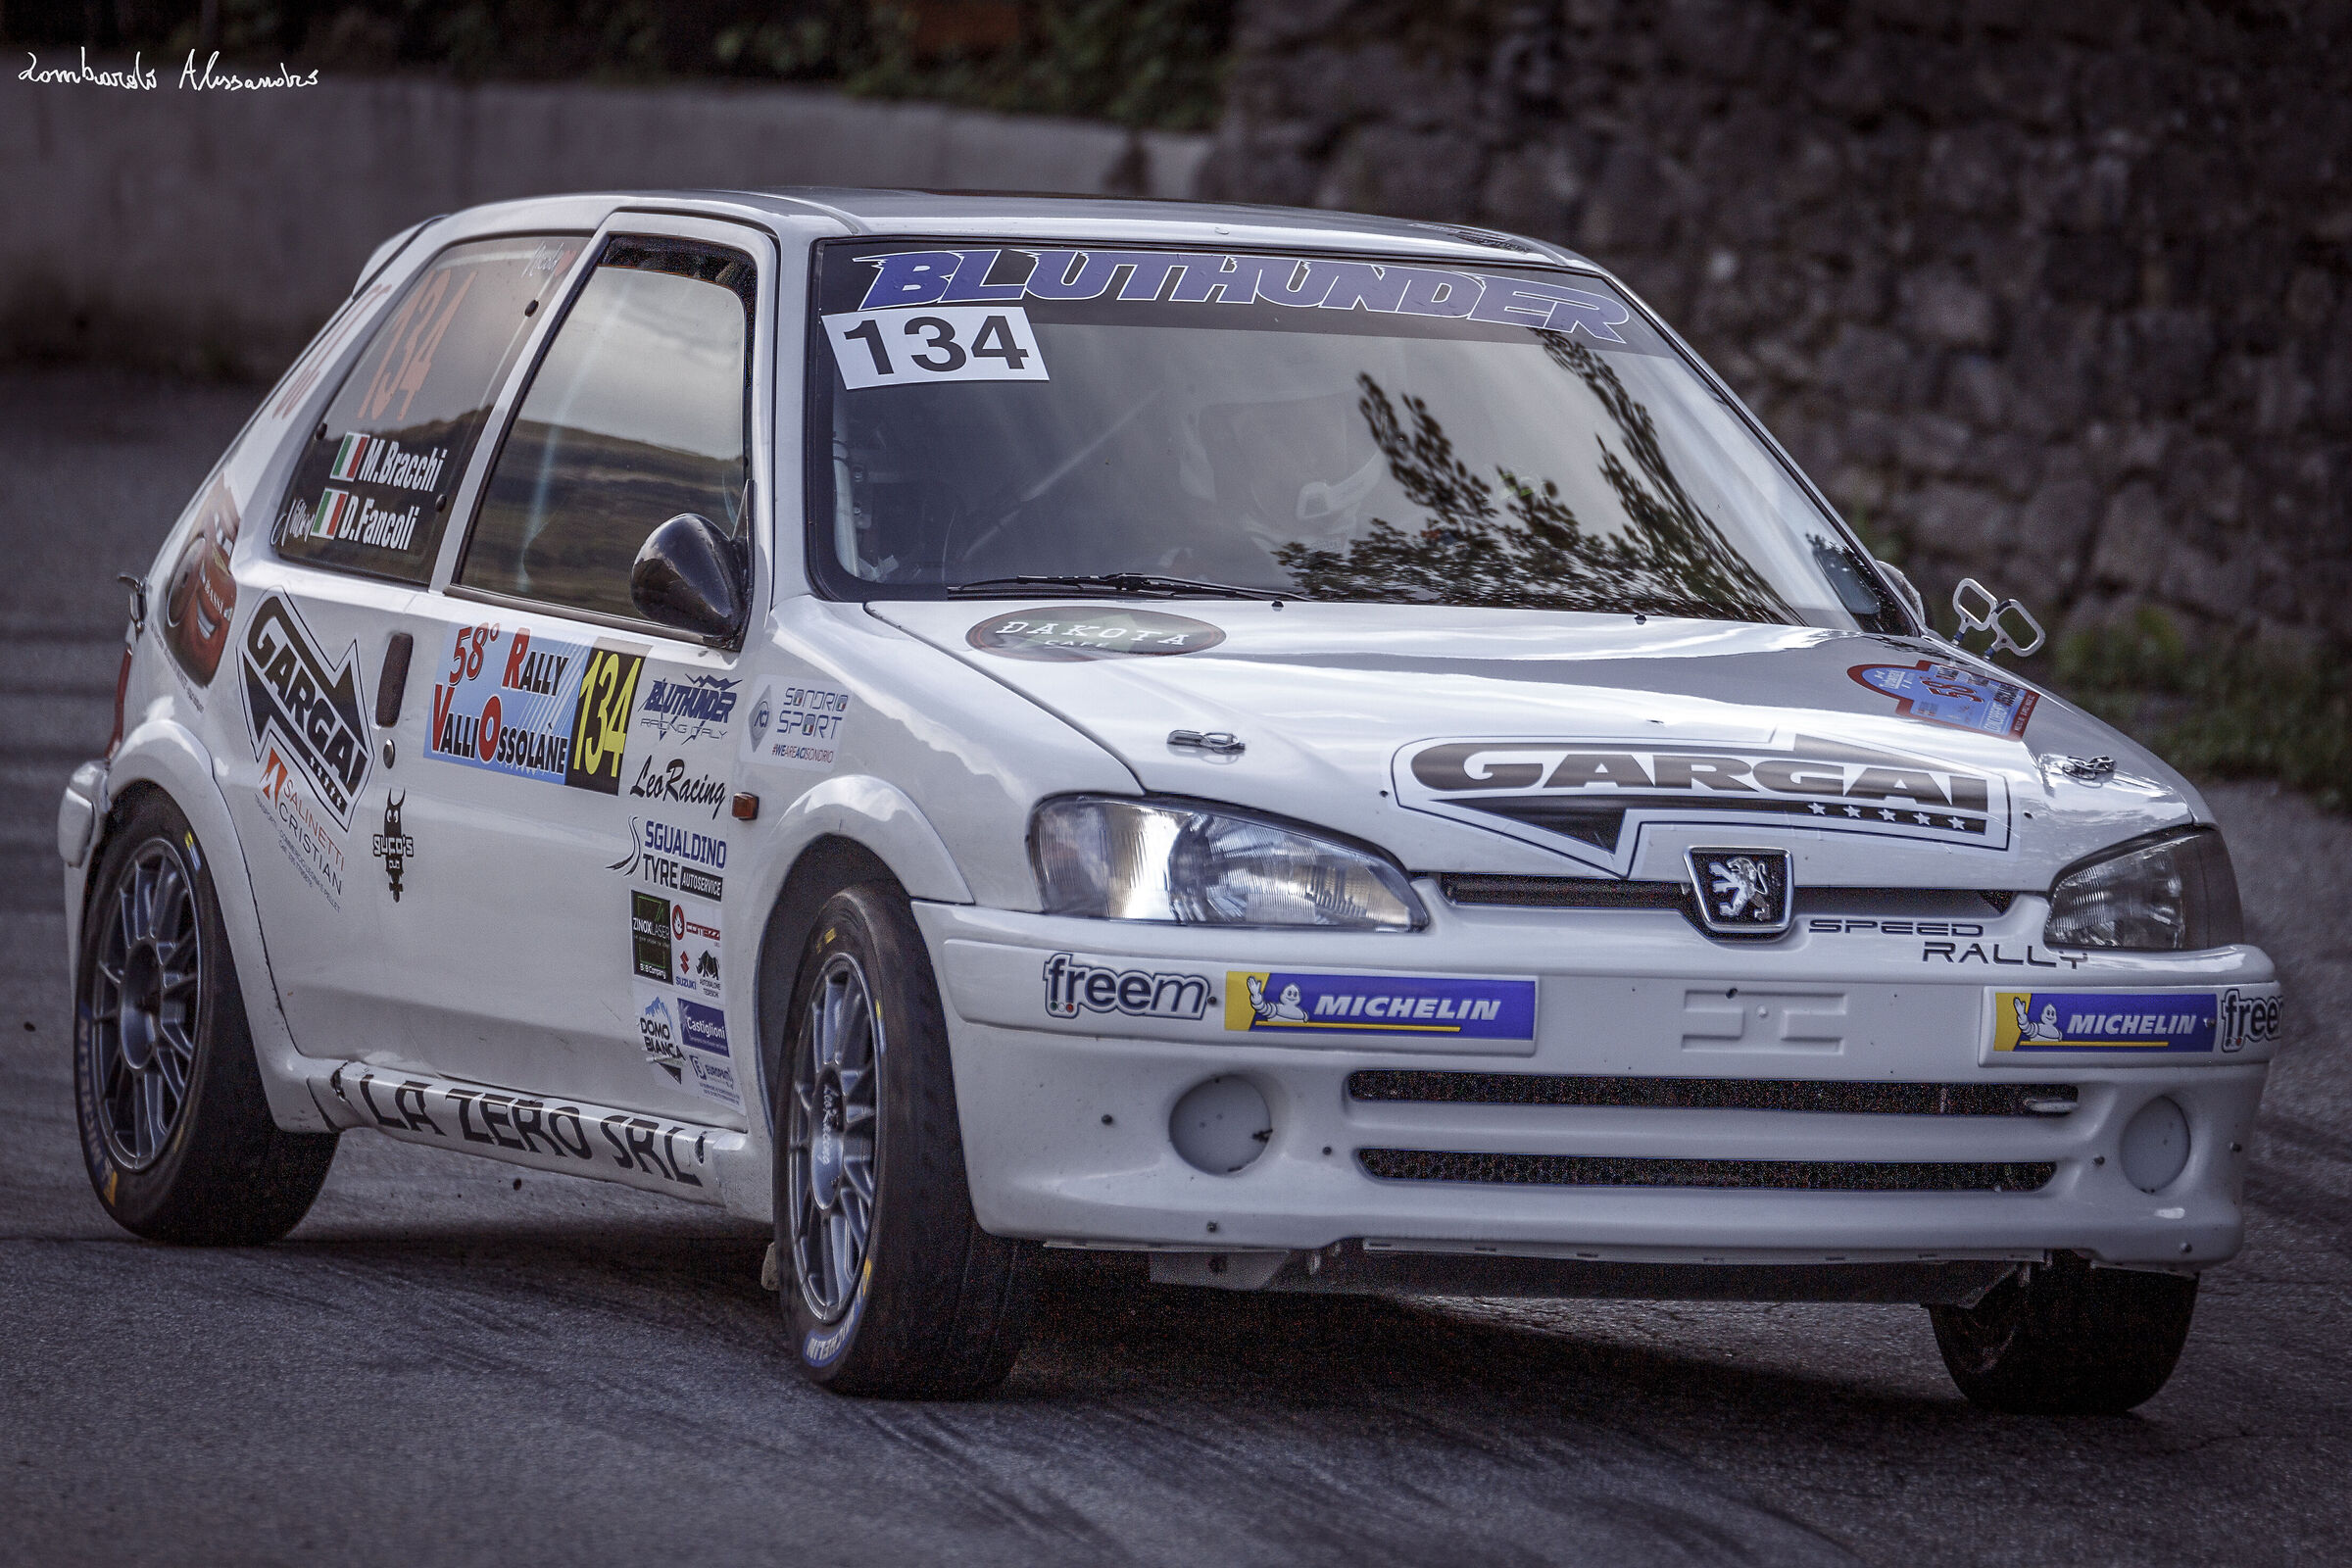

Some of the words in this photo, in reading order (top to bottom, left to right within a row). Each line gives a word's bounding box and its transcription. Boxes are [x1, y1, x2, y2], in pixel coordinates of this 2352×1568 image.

[852, 249, 1630, 344] BLUTHUNDER
[357, 268, 478, 421] 134
[843, 315, 1029, 376] 134
[996, 620, 1190, 646] DAKOTA
[501, 627, 569, 697] RALLY
[573, 651, 642, 778] 134
[643, 679, 737, 723] BLUTHUNDER
[783, 687, 849, 712] SONDRIO
[776, 710, 843, 740] SPORT
[1411, 742, 1988, 812] GARGAI
[283, 778, 345, 871] SALINETTI
[644, 820, 727, 870] SGUALDINO
[278, 802, 342, 896] CRISTIAN
[643, 853, 679, 890] TYRE
[681, 871, 721, 897] AUTOSERVICE
[1808, 919, 1984, 938] SPEED
[1922, 942, 2089, 970] RALLY
[675, 976, 697, 990] SUZUKI
[1046, 954, 1209, 1016] freem
[640, 1017, 670, 1040] DOMO
[687, 1017, 726, 1040] Castiglioni
[1313, 995, 1501, 1021] MICHELIN
[2066, 1013, 2198, 1036] MICHELIN
[2223, 991, 2282, 1048] free
[643, 1036, 687, 1061] BIANCA
[359, 1074, 447, 1137] LA
[600, 1114, 703, 1188] SRL
